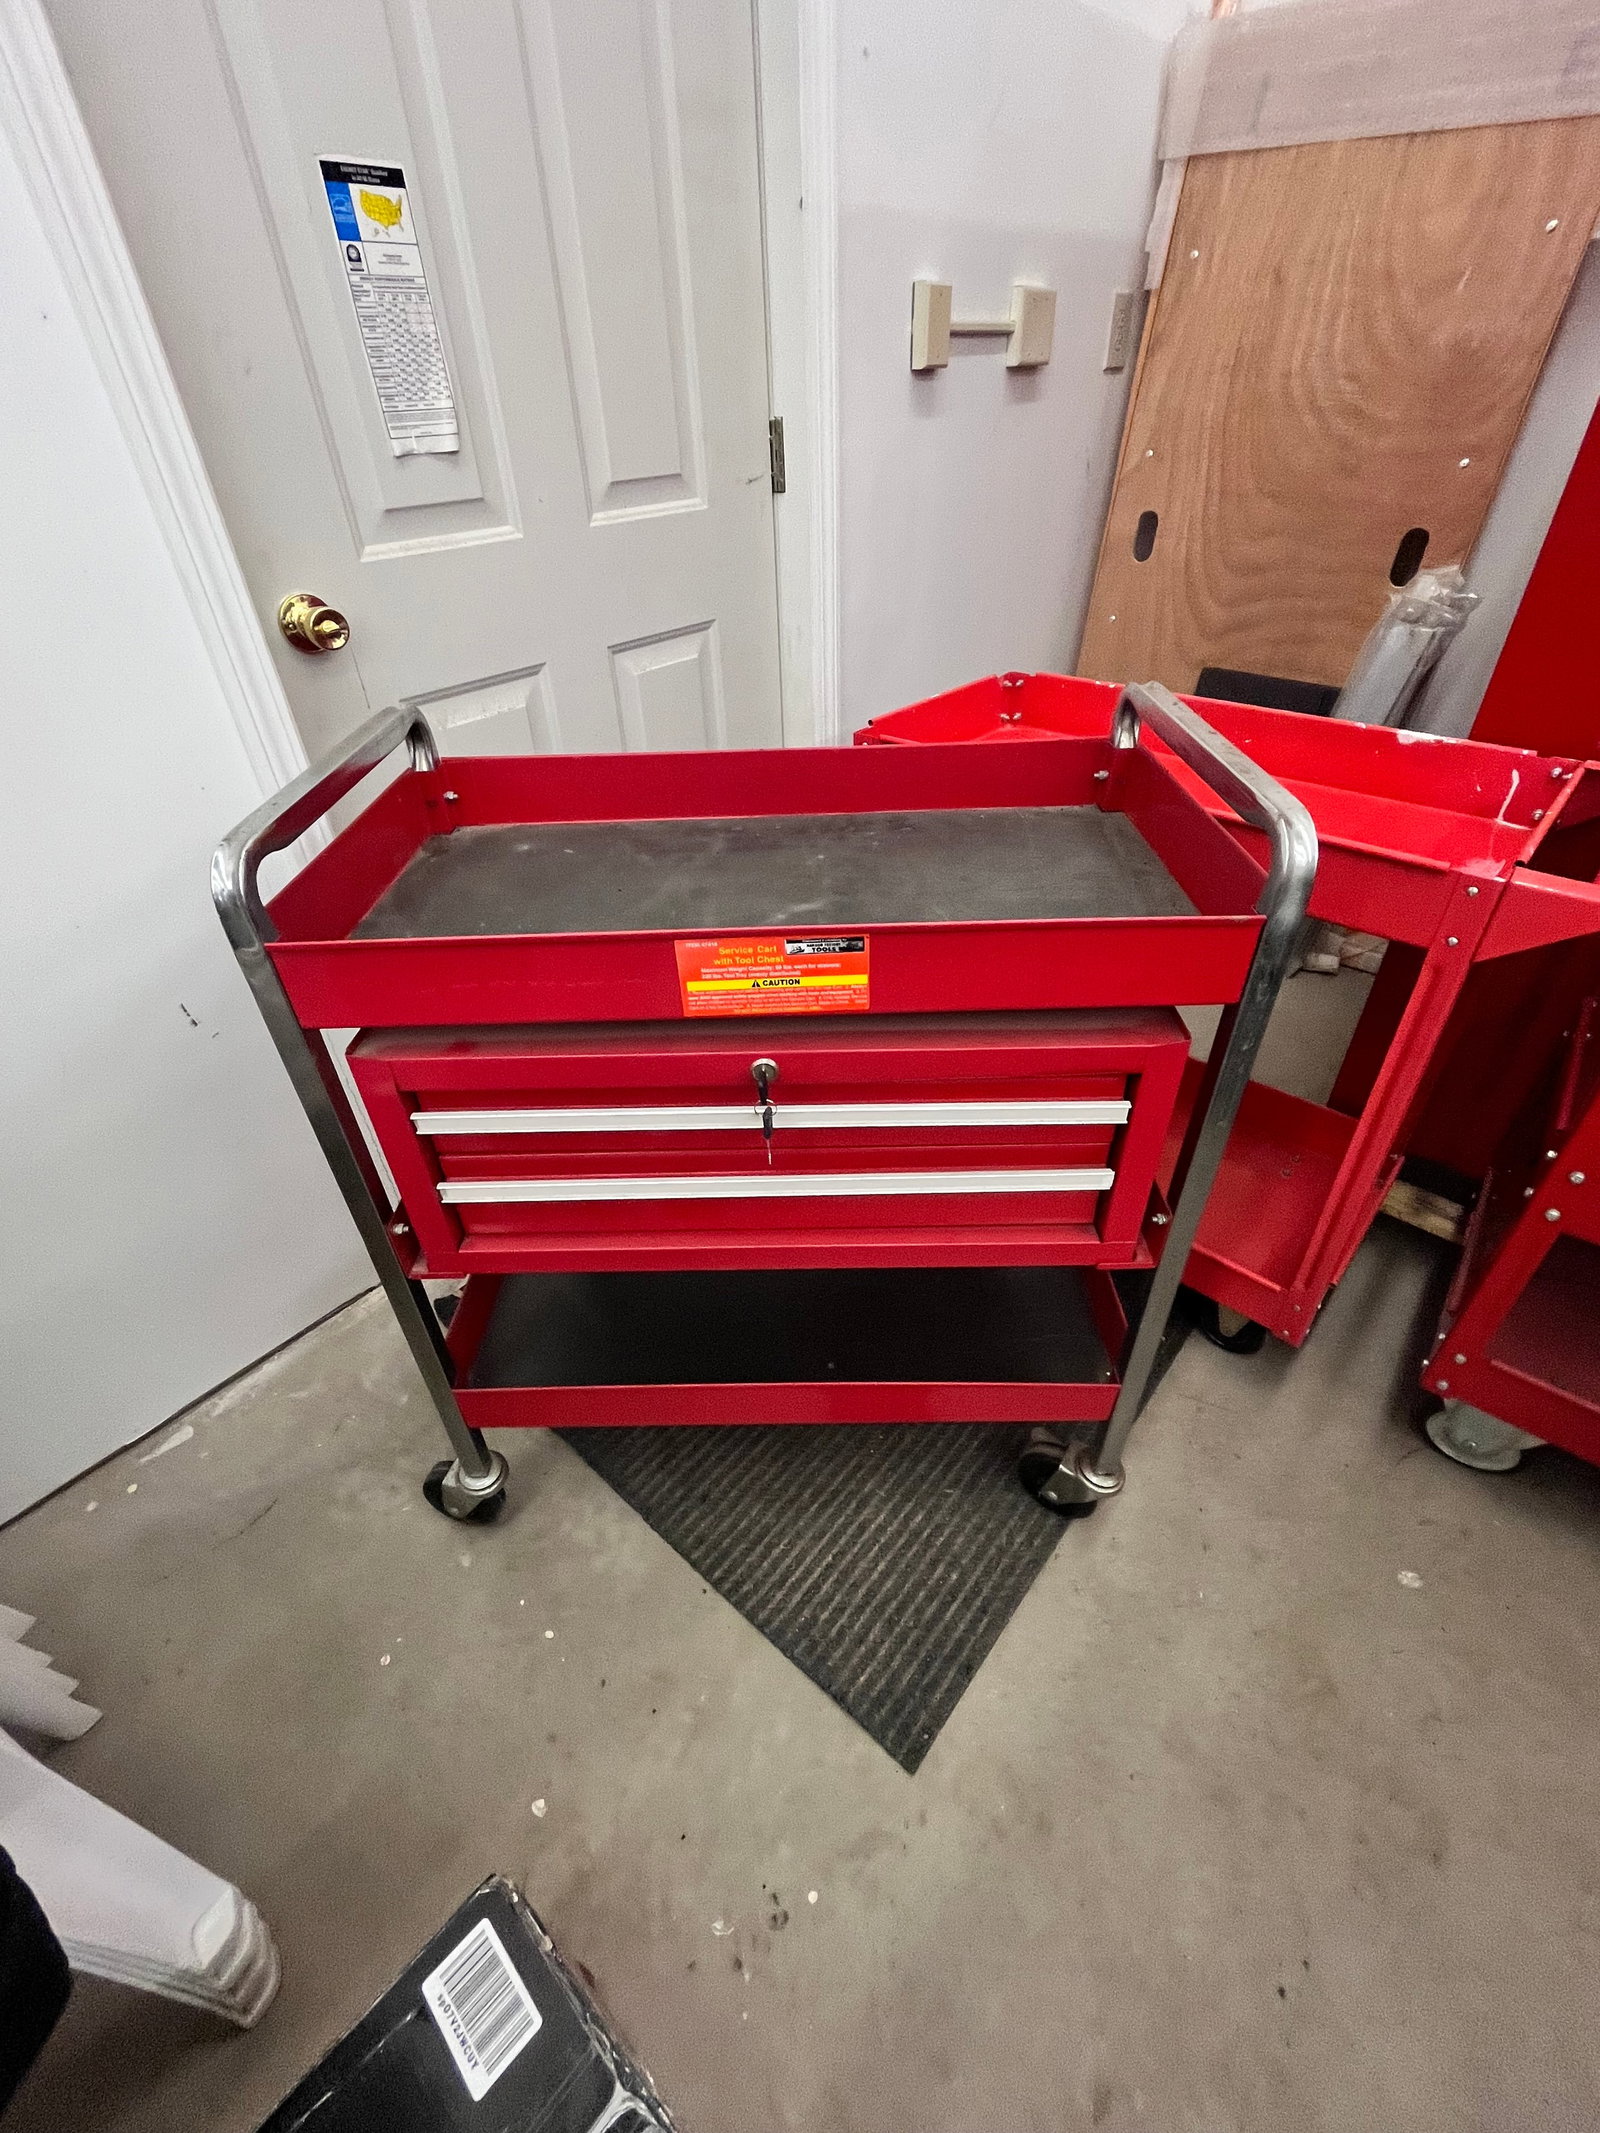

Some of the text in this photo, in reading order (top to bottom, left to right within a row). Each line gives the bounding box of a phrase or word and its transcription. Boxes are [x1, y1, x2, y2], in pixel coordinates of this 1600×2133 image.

[718, 945, 777, 955] Service Cart
[713, 957, 733, 965] with
[757, 955, 784, 964] Chest
[762, 978, 801, 987] CAUTION
